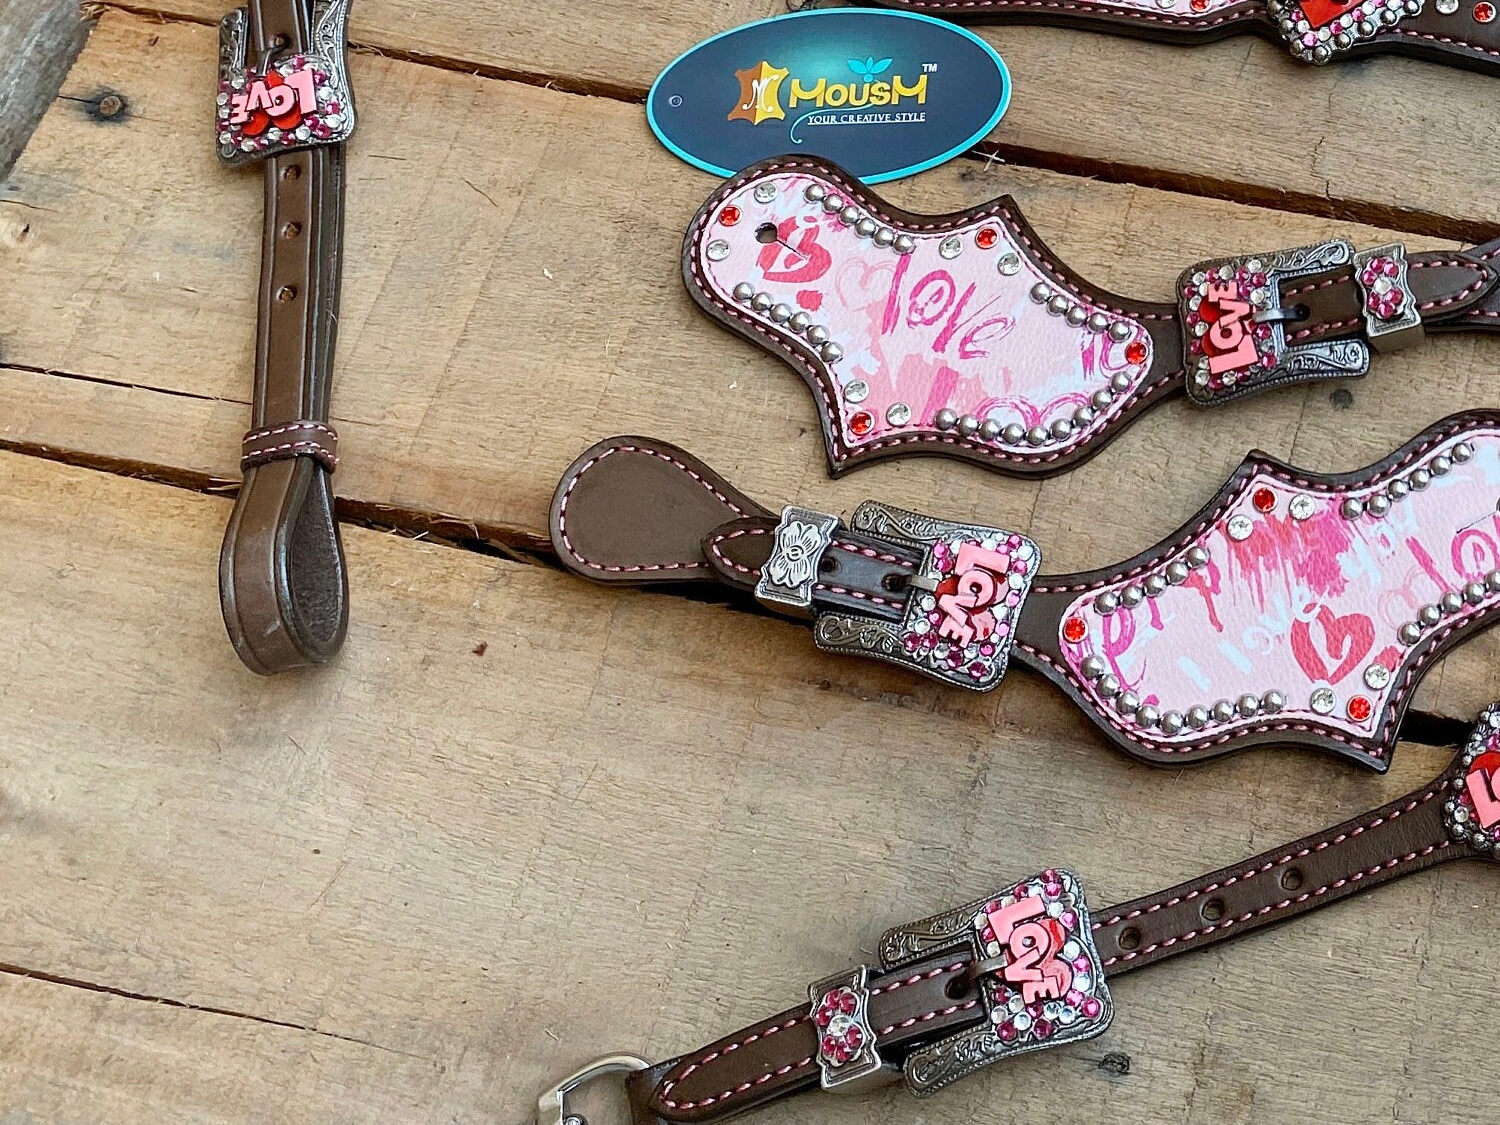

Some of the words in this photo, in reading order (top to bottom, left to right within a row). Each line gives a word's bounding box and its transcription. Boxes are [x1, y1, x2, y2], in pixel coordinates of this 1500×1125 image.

[230, 69, 318, 124] LOVE
[922, 63, 938, 73] TM
[807, 115, 837, 125] YOUR
[840, 113, 892, 124] CREATIVE
[894, 112, 926, 123] STYLE
[1207, 280, 1259, 374] LOVE
[938, 542, 1010, 648] LOVE
[988, 895, 1063, 1004] LOVE
